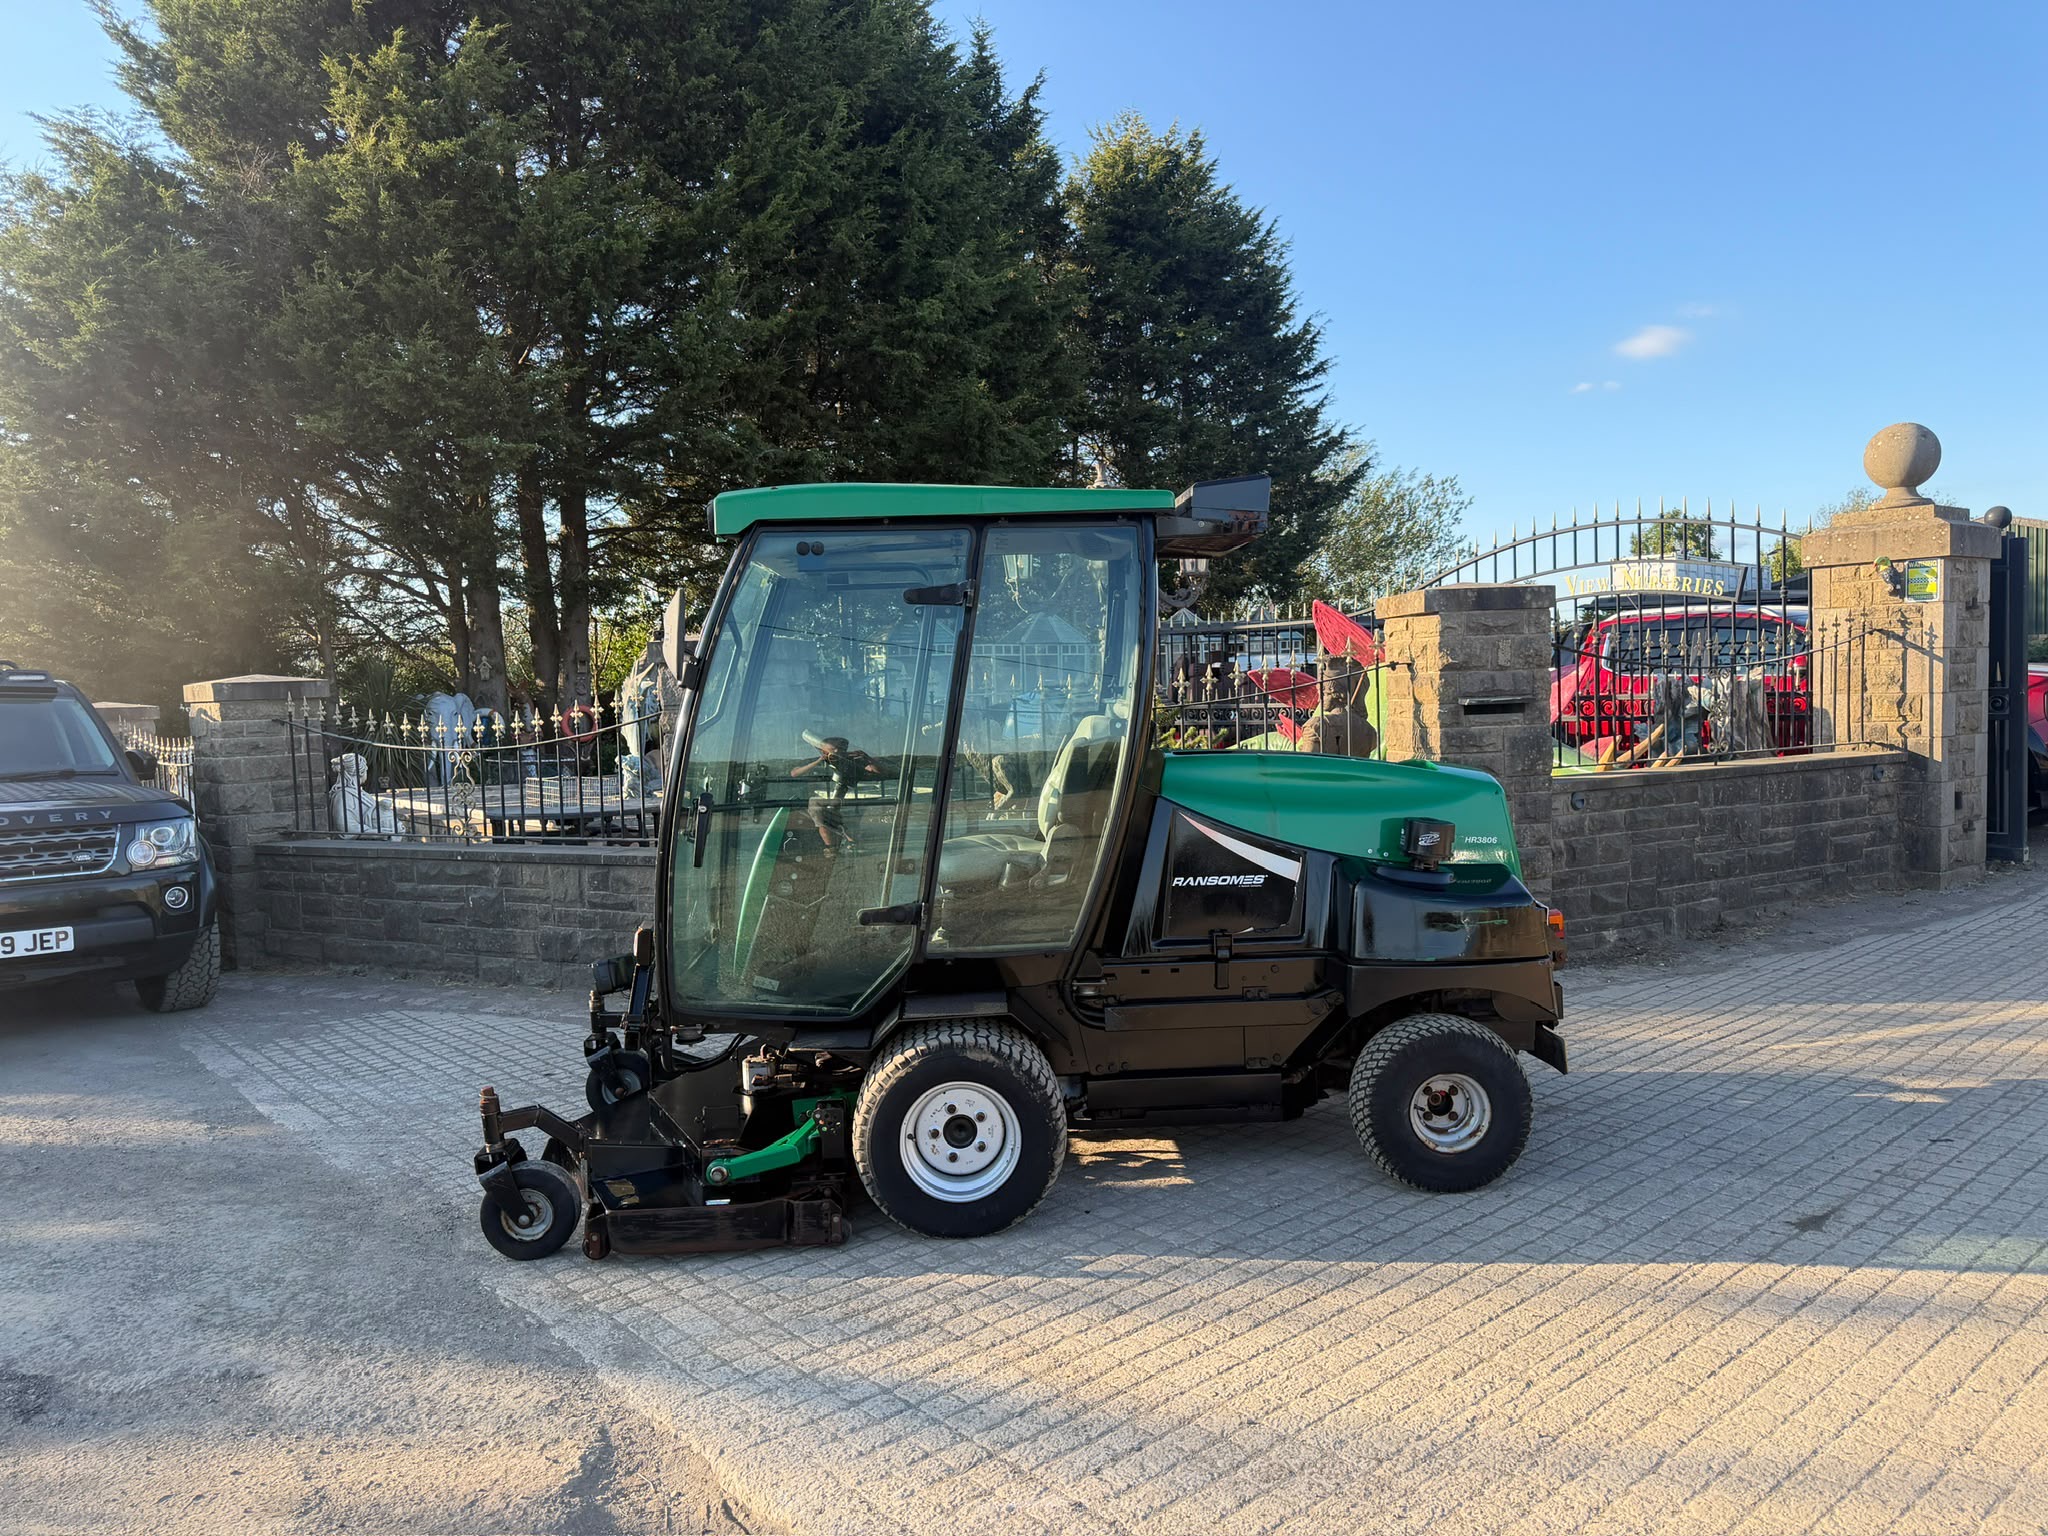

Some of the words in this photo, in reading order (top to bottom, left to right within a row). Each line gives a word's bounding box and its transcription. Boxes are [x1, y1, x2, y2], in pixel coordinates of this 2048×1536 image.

[1565, 575, 1610, 596] VIEW
[1464, 836, 1498, 845] HR3806
[1172, 874, 1266, 887] RANSOMES
[24, 930, 69, 952] JEP
